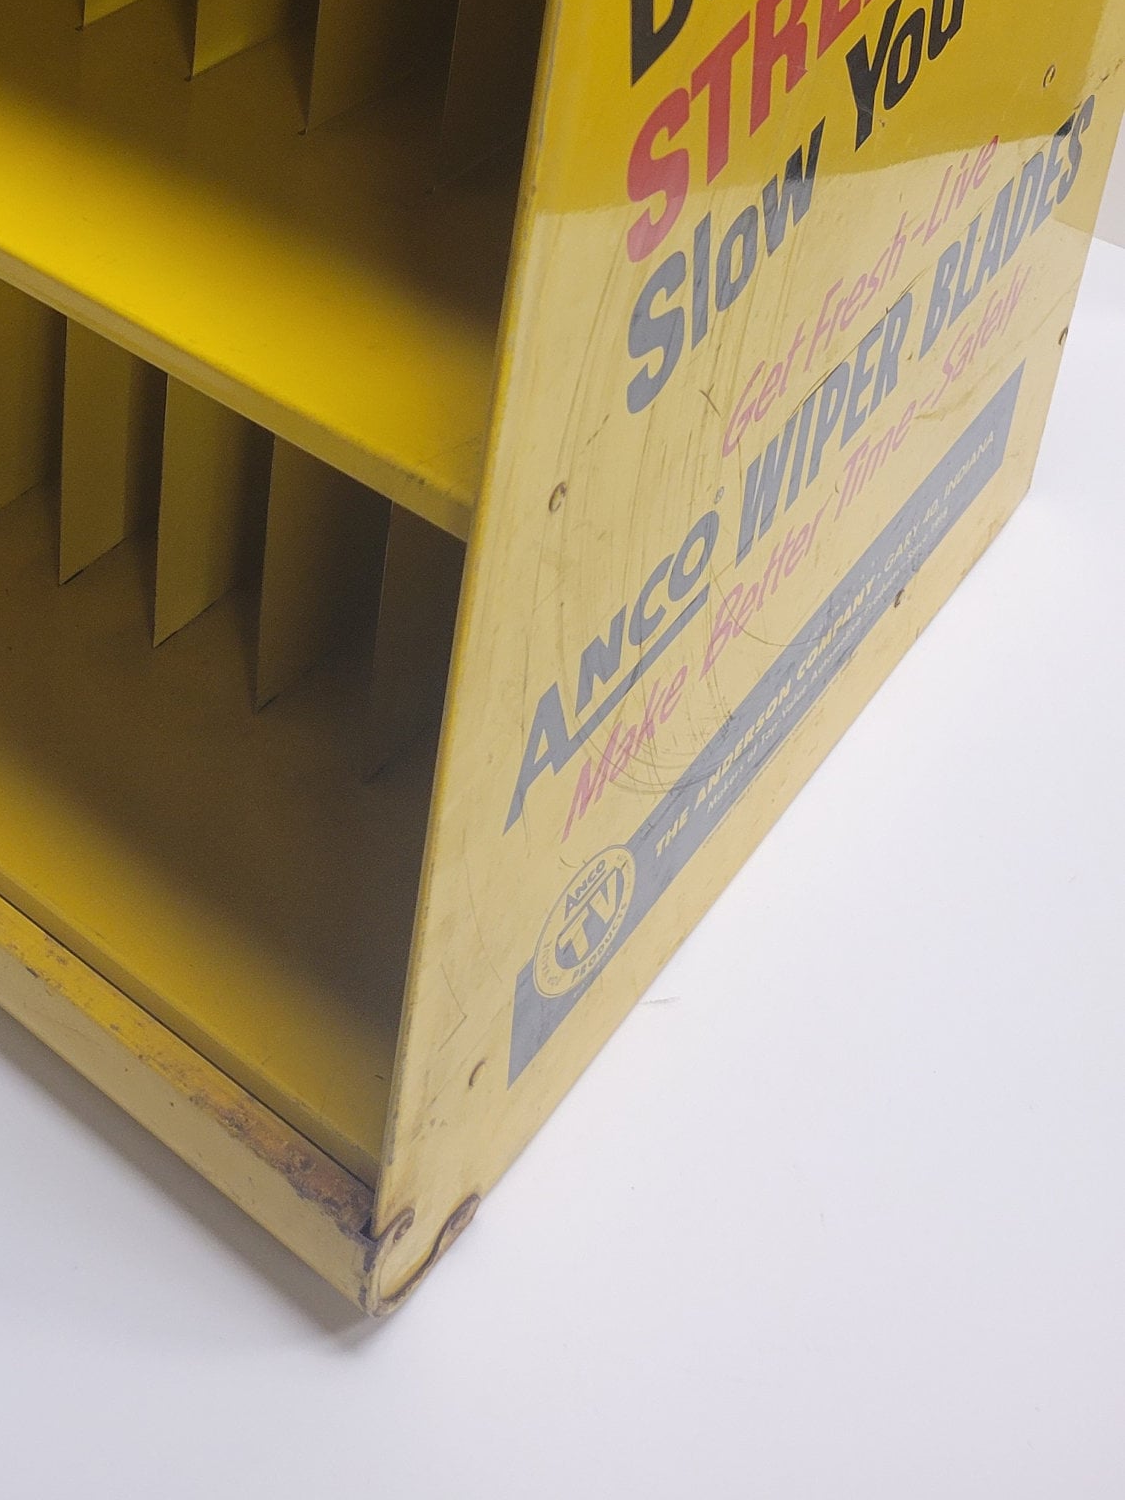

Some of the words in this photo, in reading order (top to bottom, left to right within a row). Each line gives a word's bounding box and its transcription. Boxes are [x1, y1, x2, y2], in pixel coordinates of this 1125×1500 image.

[626, 116, 825, 414] Slow
[722, 321, 806, 458] Get
[736, 291, 912, 568] WIPER
[920, 94, 1095, 361] BLADES
[562, 664, 687, 844] Make
[699, 493, 832, 683] Better
[656, 806, 689, 858] THE
[694, 679, 791, 811] ANDERSON
[797, 574, 875, 680] COMPANY
[944, 431, 994, 500] INDIANA
[560, 869, 616, 961] TV
[564, 859, 606, 921] ANCO
